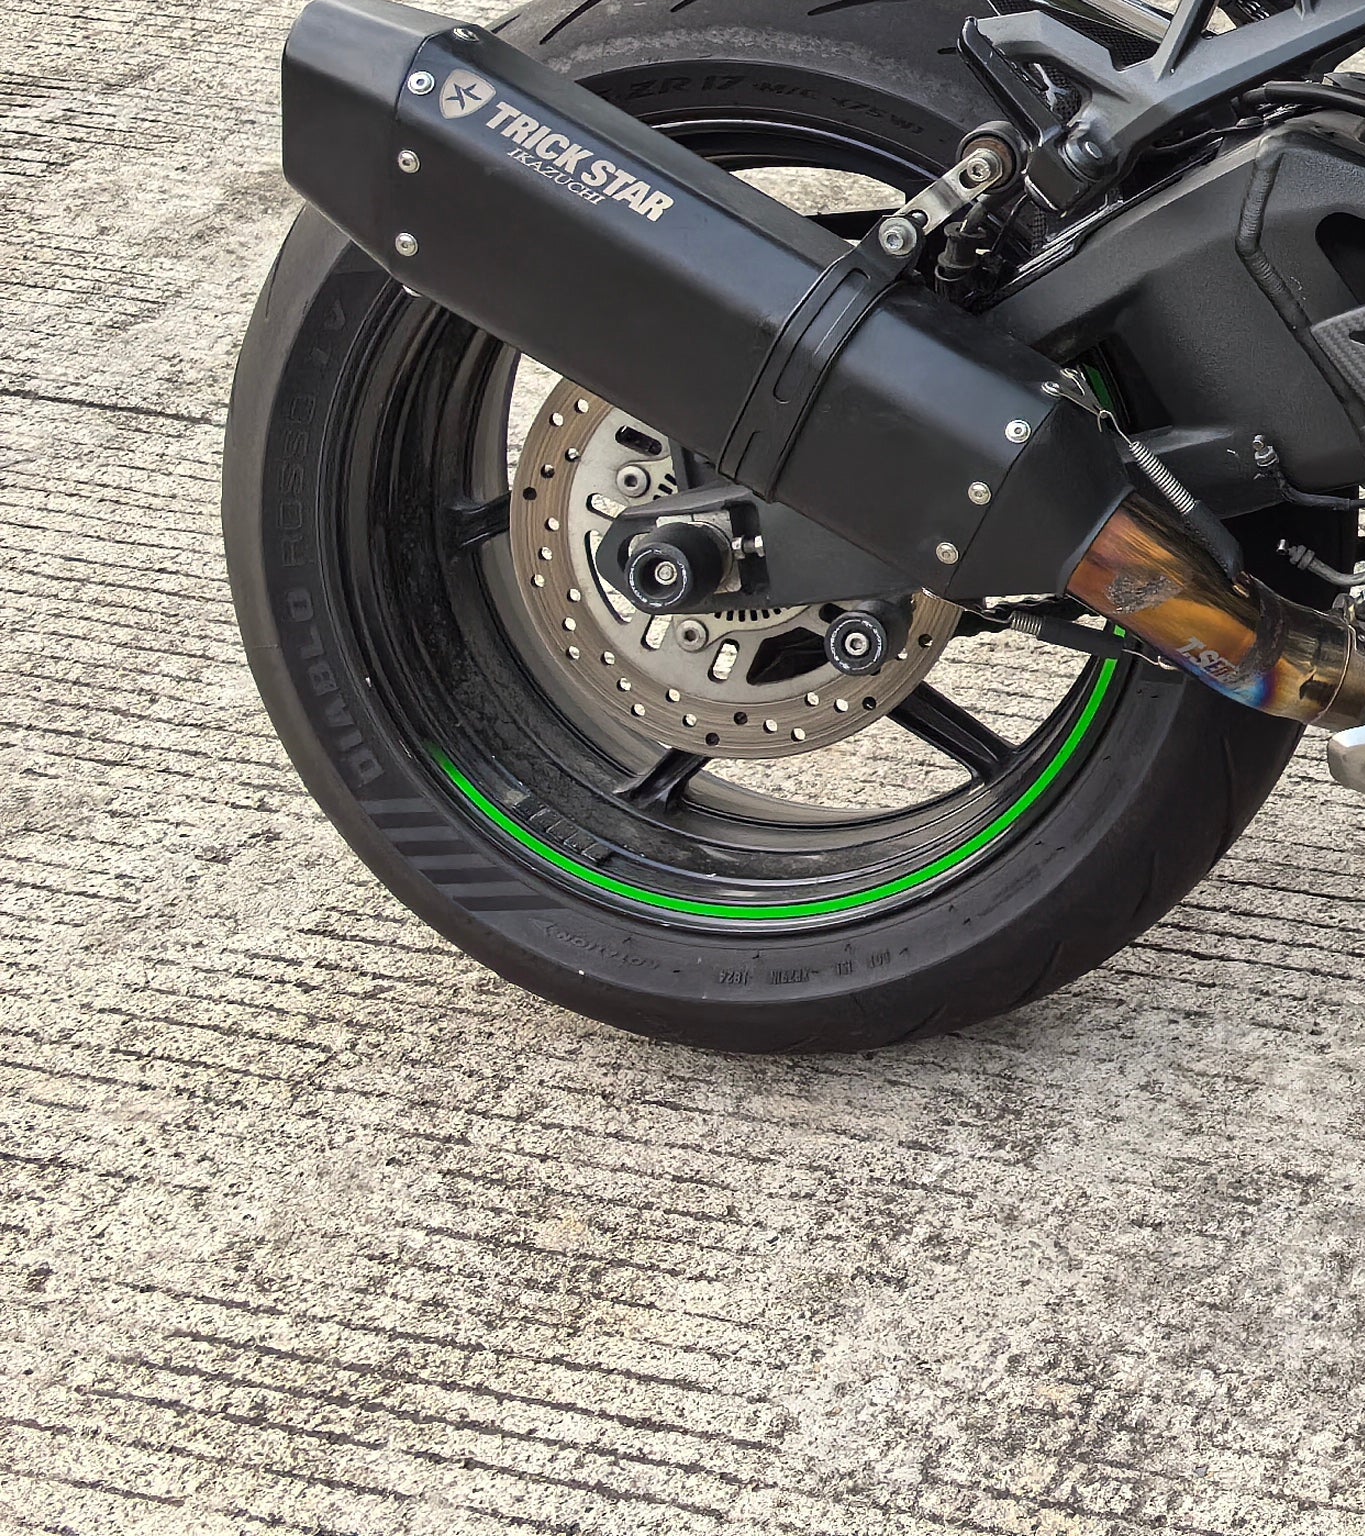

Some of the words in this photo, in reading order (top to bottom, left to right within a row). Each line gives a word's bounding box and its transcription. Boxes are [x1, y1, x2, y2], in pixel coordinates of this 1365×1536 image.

[486, 101, 594, 174] TRICK
[580, 159, 674, 222] STAR
[507, 147, 606, 206] IKAZUCHI
[286, 587, 386, 788] DIABLO
